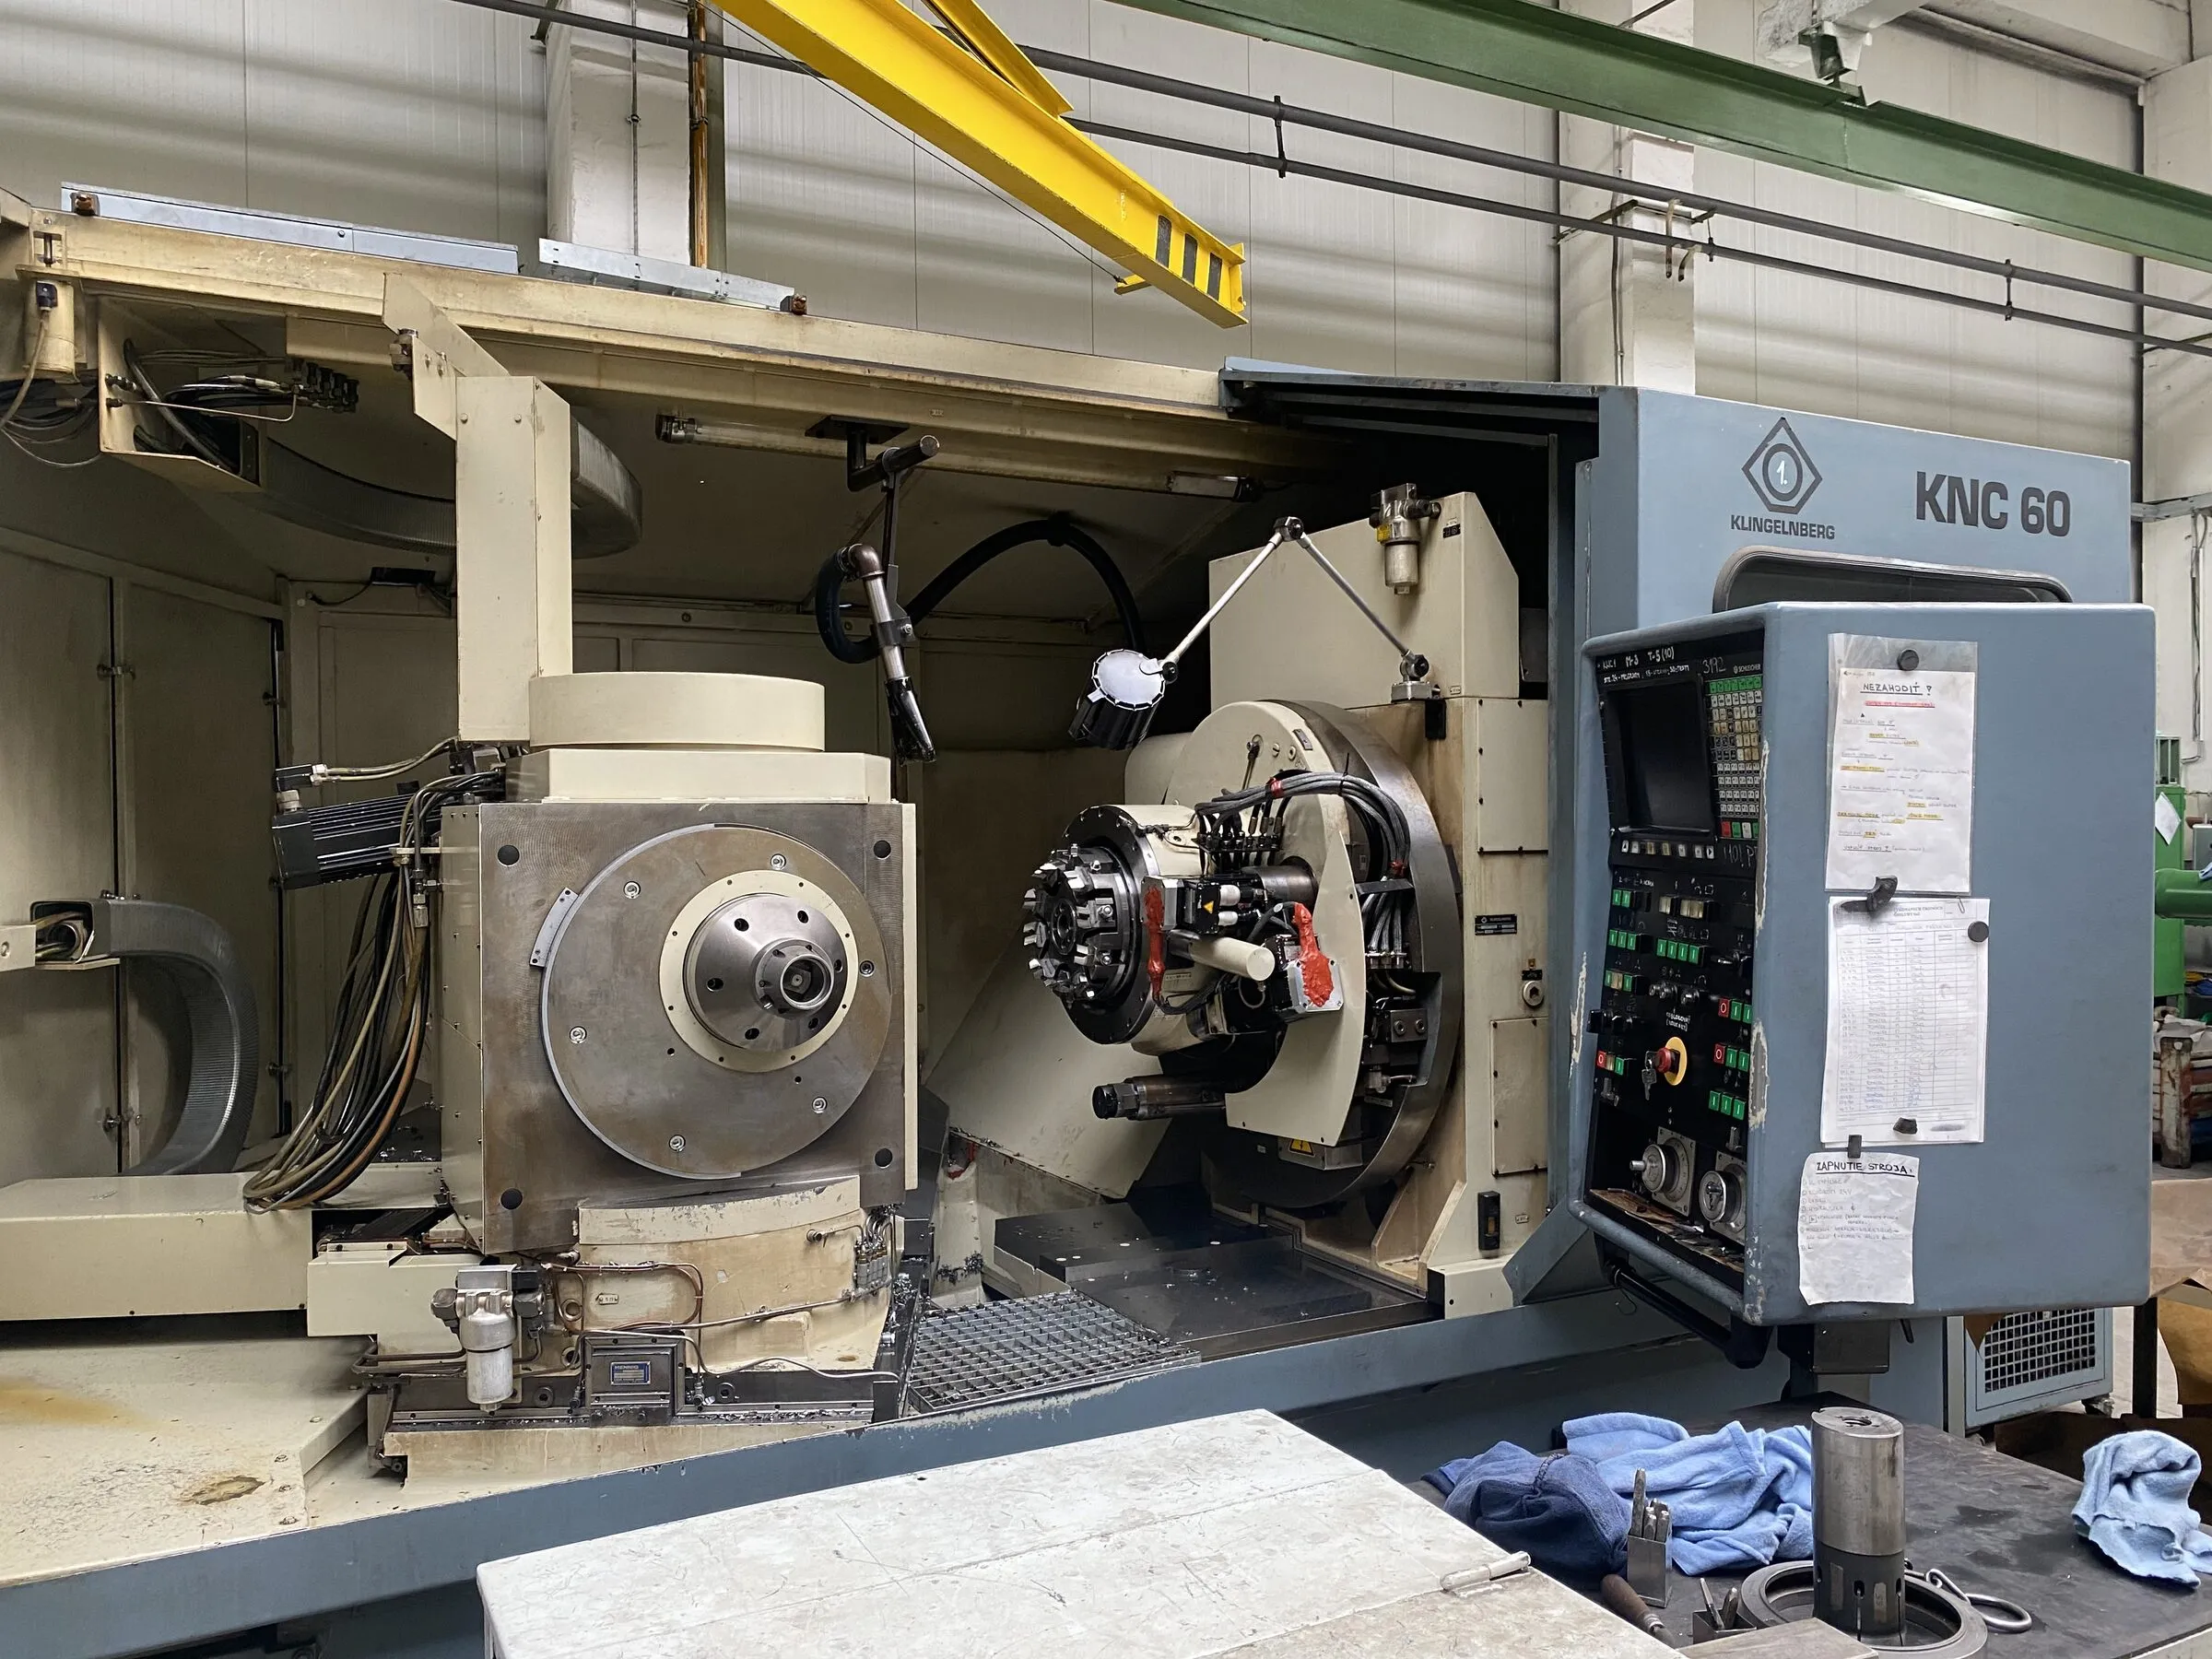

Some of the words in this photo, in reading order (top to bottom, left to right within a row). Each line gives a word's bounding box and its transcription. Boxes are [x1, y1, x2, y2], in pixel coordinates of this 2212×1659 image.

[1916, 470, 2008, 530] KNC
[2020, 487, 2071, 537] 60
[1730, 514, 1835, 540] KLINGELNBERG
[1816, 1161, 1863, 1171] ZAPNUTIE
